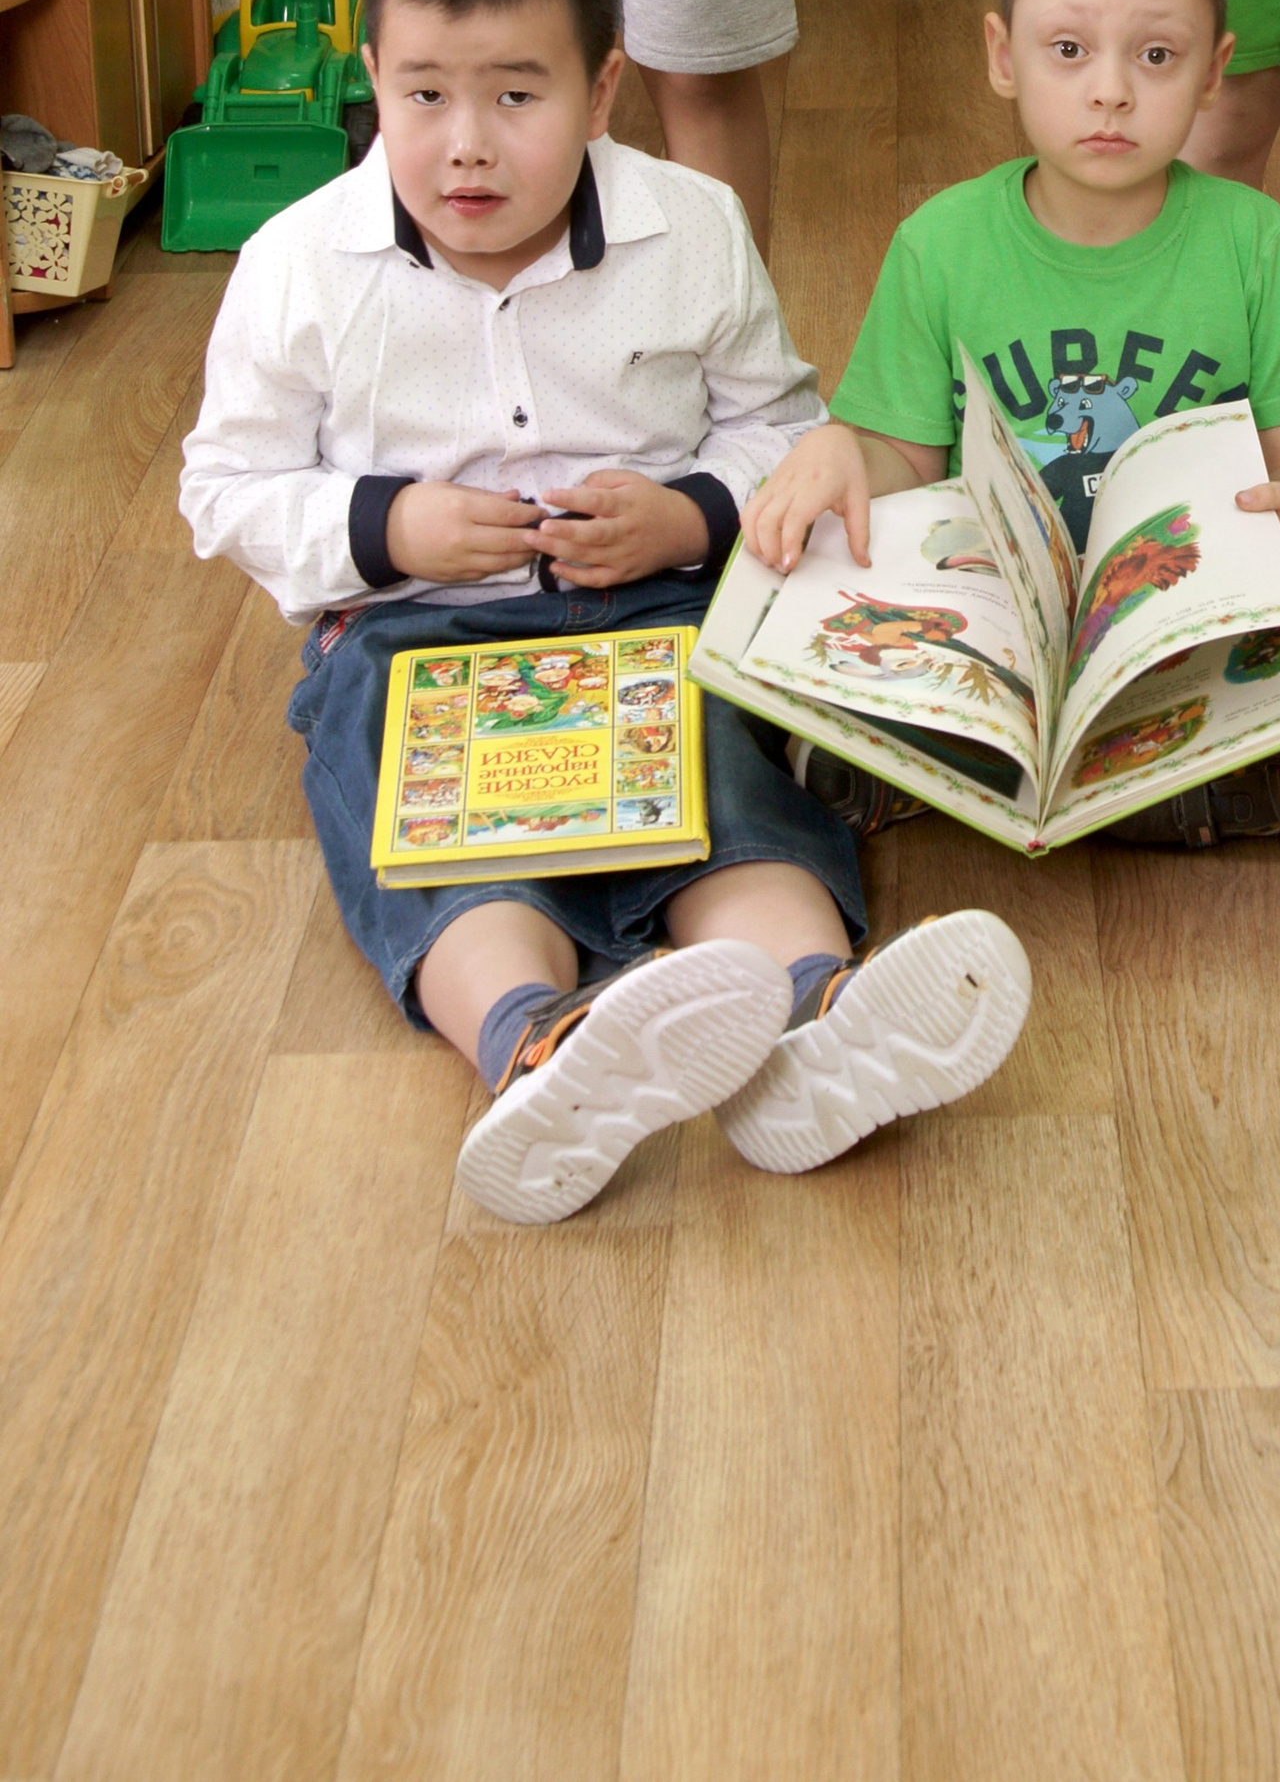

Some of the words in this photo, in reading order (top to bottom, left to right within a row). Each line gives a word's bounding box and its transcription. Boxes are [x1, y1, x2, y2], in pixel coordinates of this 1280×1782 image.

[629, 351, 643, 365] F
[952, 328, 1248, 422] URFE
[480, 743, 600, 766] СКАЗКИ
[479, 759, 598, 780] народные
[478, 771, 599, 795] РУССКИЕ
